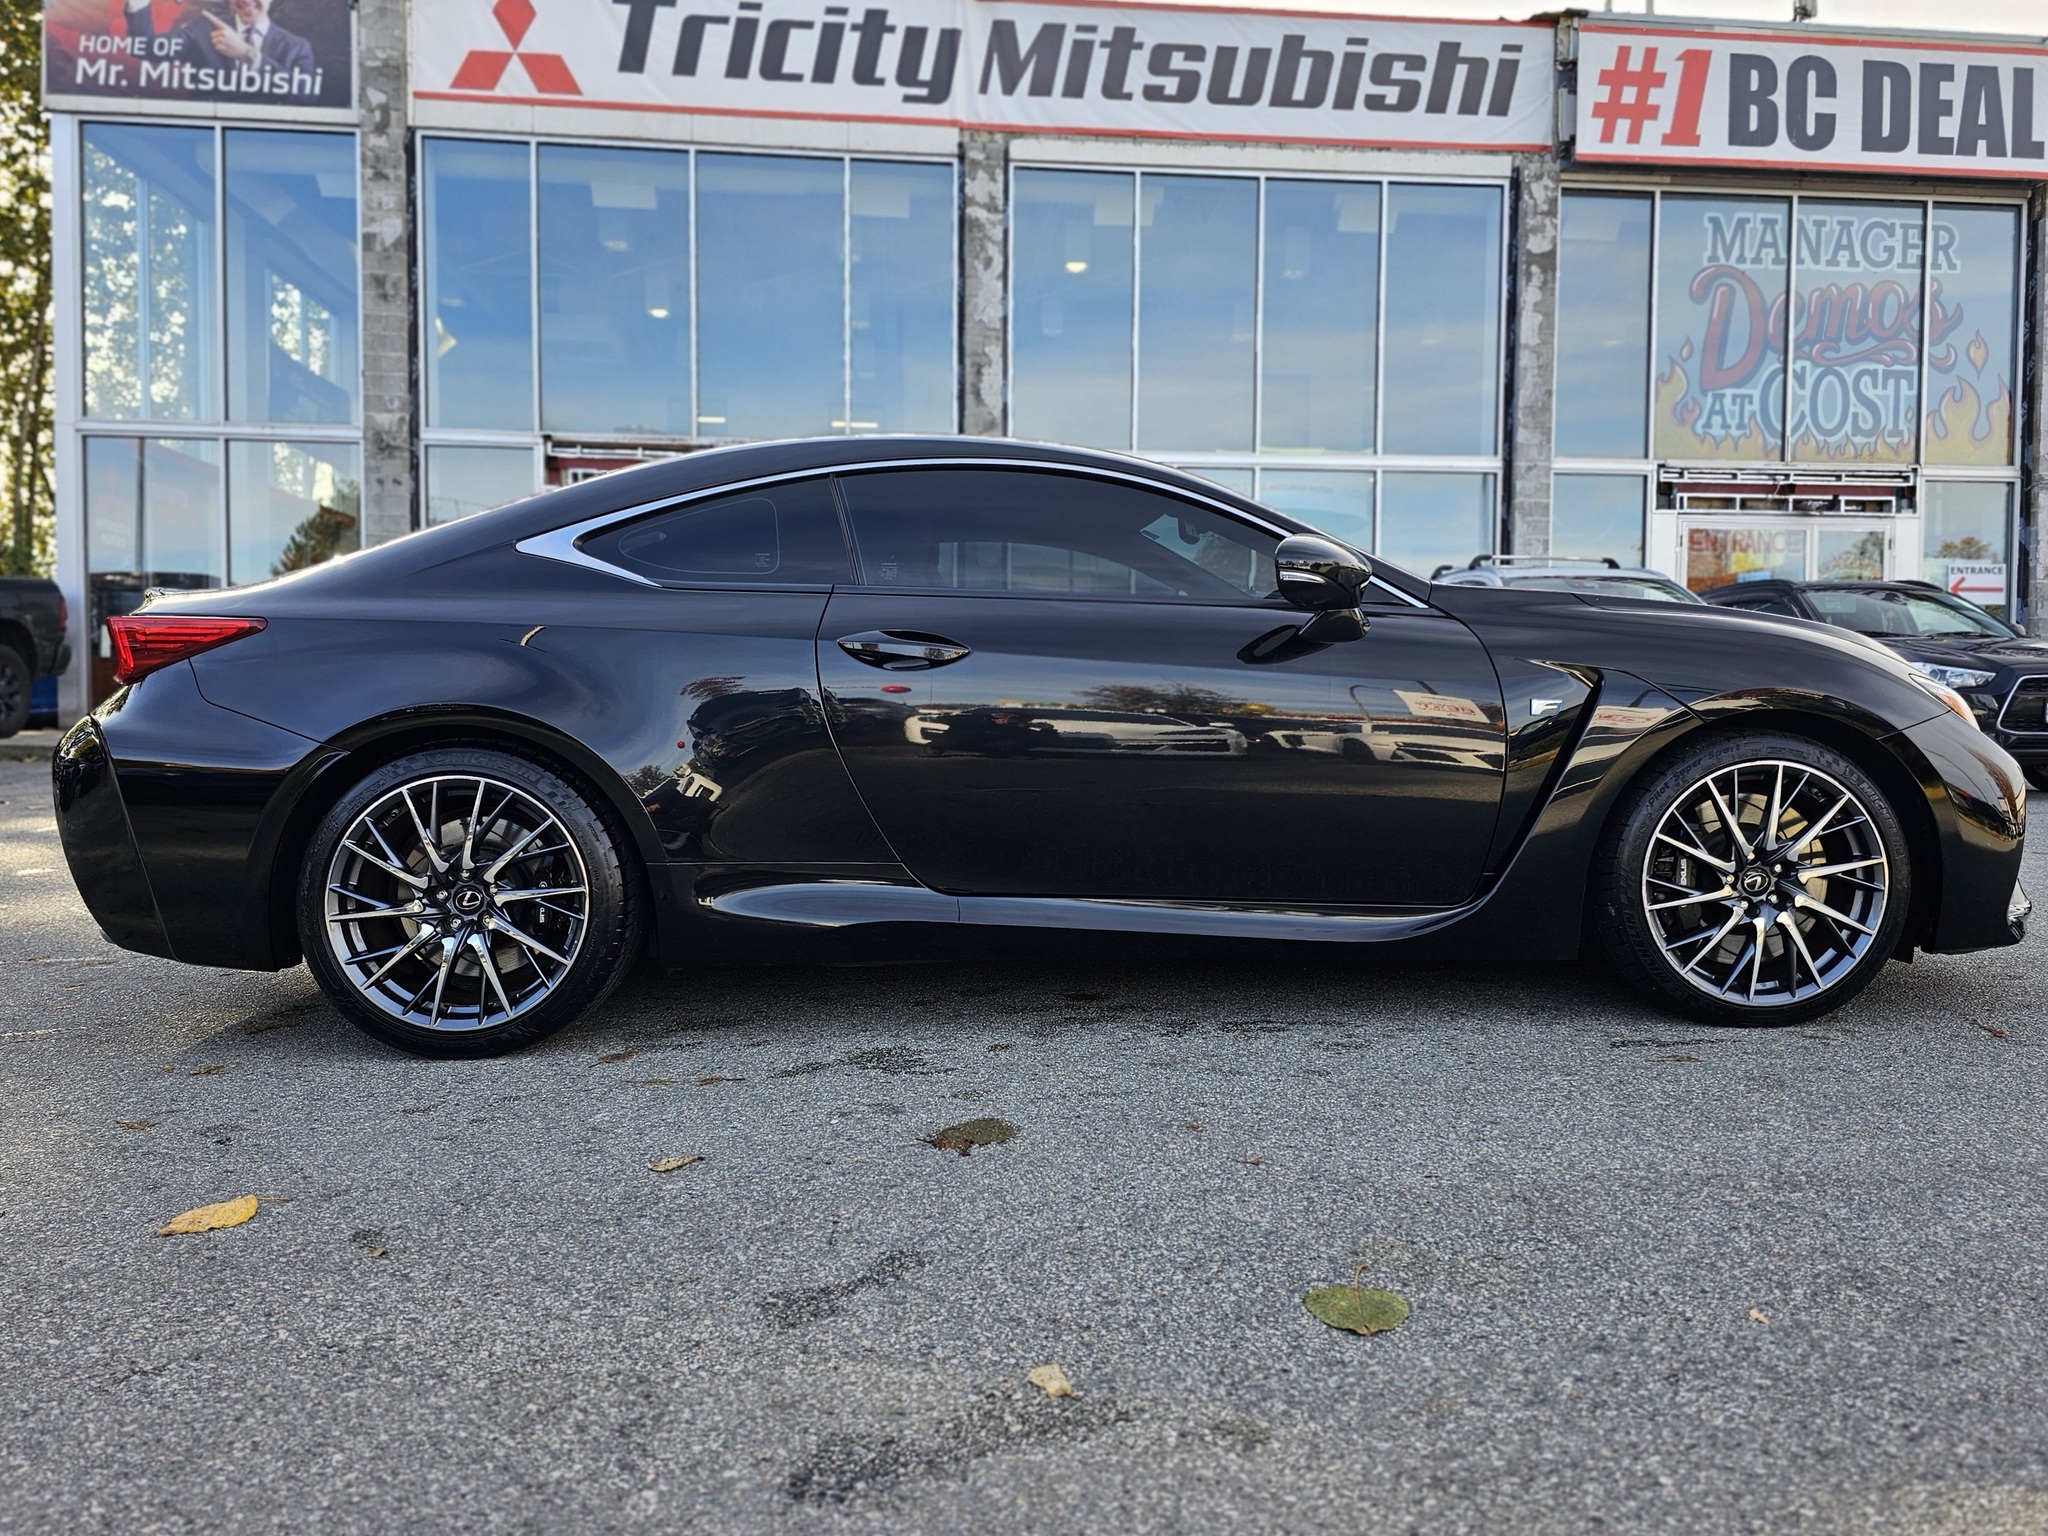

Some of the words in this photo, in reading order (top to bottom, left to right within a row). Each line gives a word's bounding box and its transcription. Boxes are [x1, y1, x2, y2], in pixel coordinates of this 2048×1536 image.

[79, 35, 147, 56] HOME
[153, 37, 184, 56] OF
[611, 0, 962, 105] Tricity
[978, 19, 1524, 117] Mitsubishi
[75, 57, 128, 87] Mr.
[139, 60, 324, 96] Mitsubishi
[1591, 45, 1712, 147] #1
[1728, 52, 1838, 152] BC
[1861, 59, 2046, 159] DEAL
[1705, 214, 1960, 272] MANAGER
[1691, 264, 1965, 392] Demos
[1702, 392, 1754, 430] AT
[1759, 364, 1915, 440] COST
[1688, 528, 1800, 553] ENTRANCE
[1950, 566, 2004, 575] ENTRANCE
